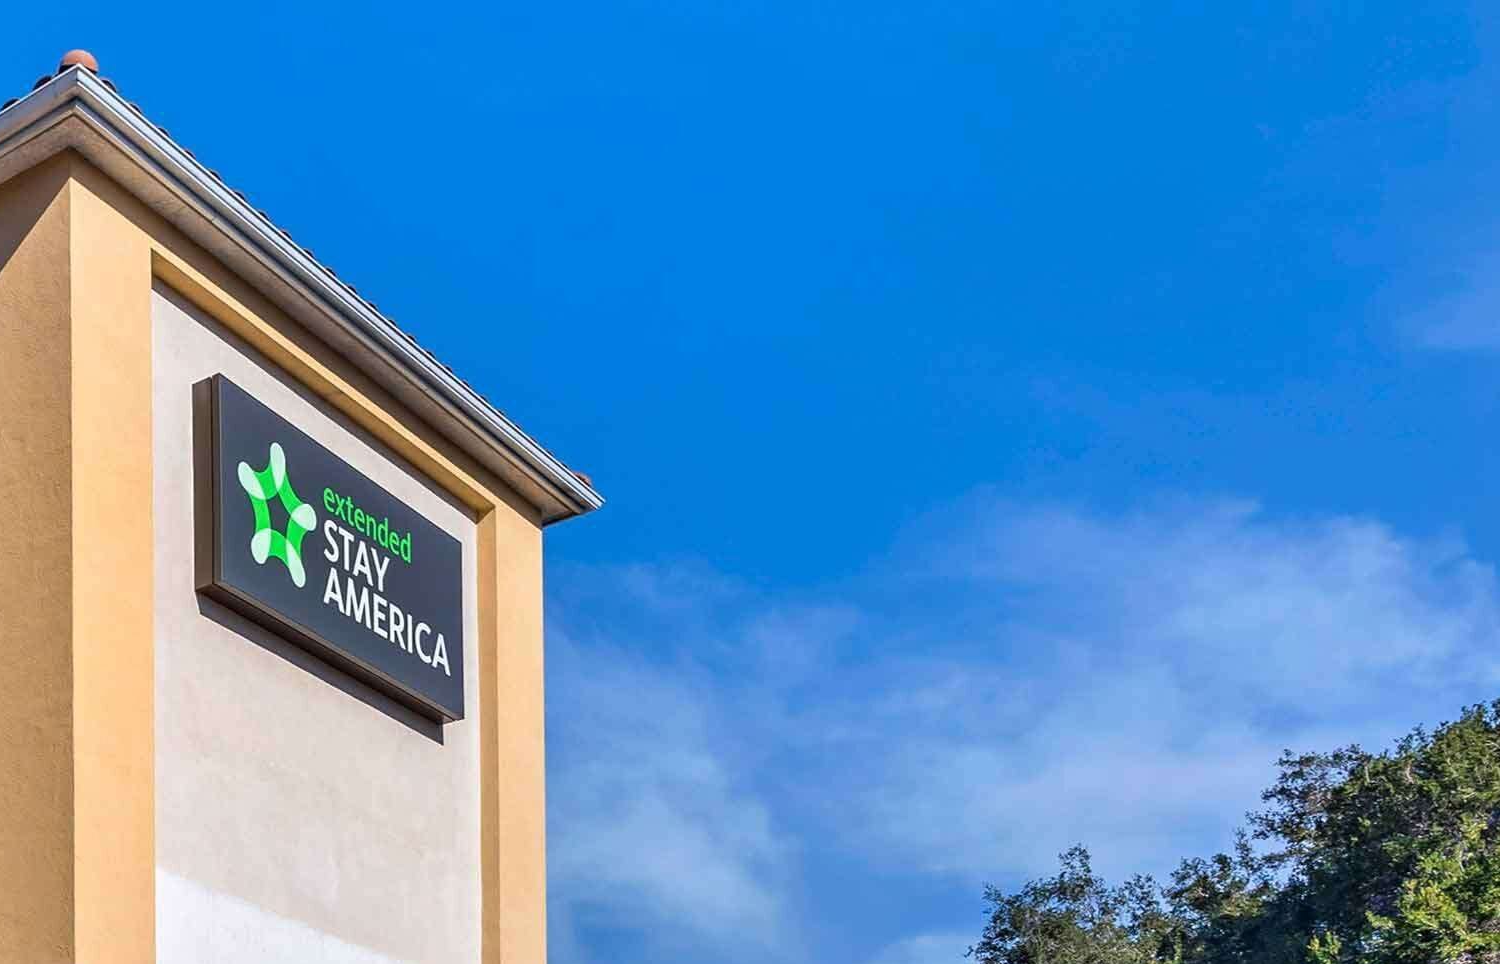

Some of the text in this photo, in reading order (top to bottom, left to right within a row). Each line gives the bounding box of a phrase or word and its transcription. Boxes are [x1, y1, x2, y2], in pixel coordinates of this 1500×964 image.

[323, 487, 411, 565] extended
[323, 520, 391, 593] STAY
[323, 568, 451, 676] AMERICA
